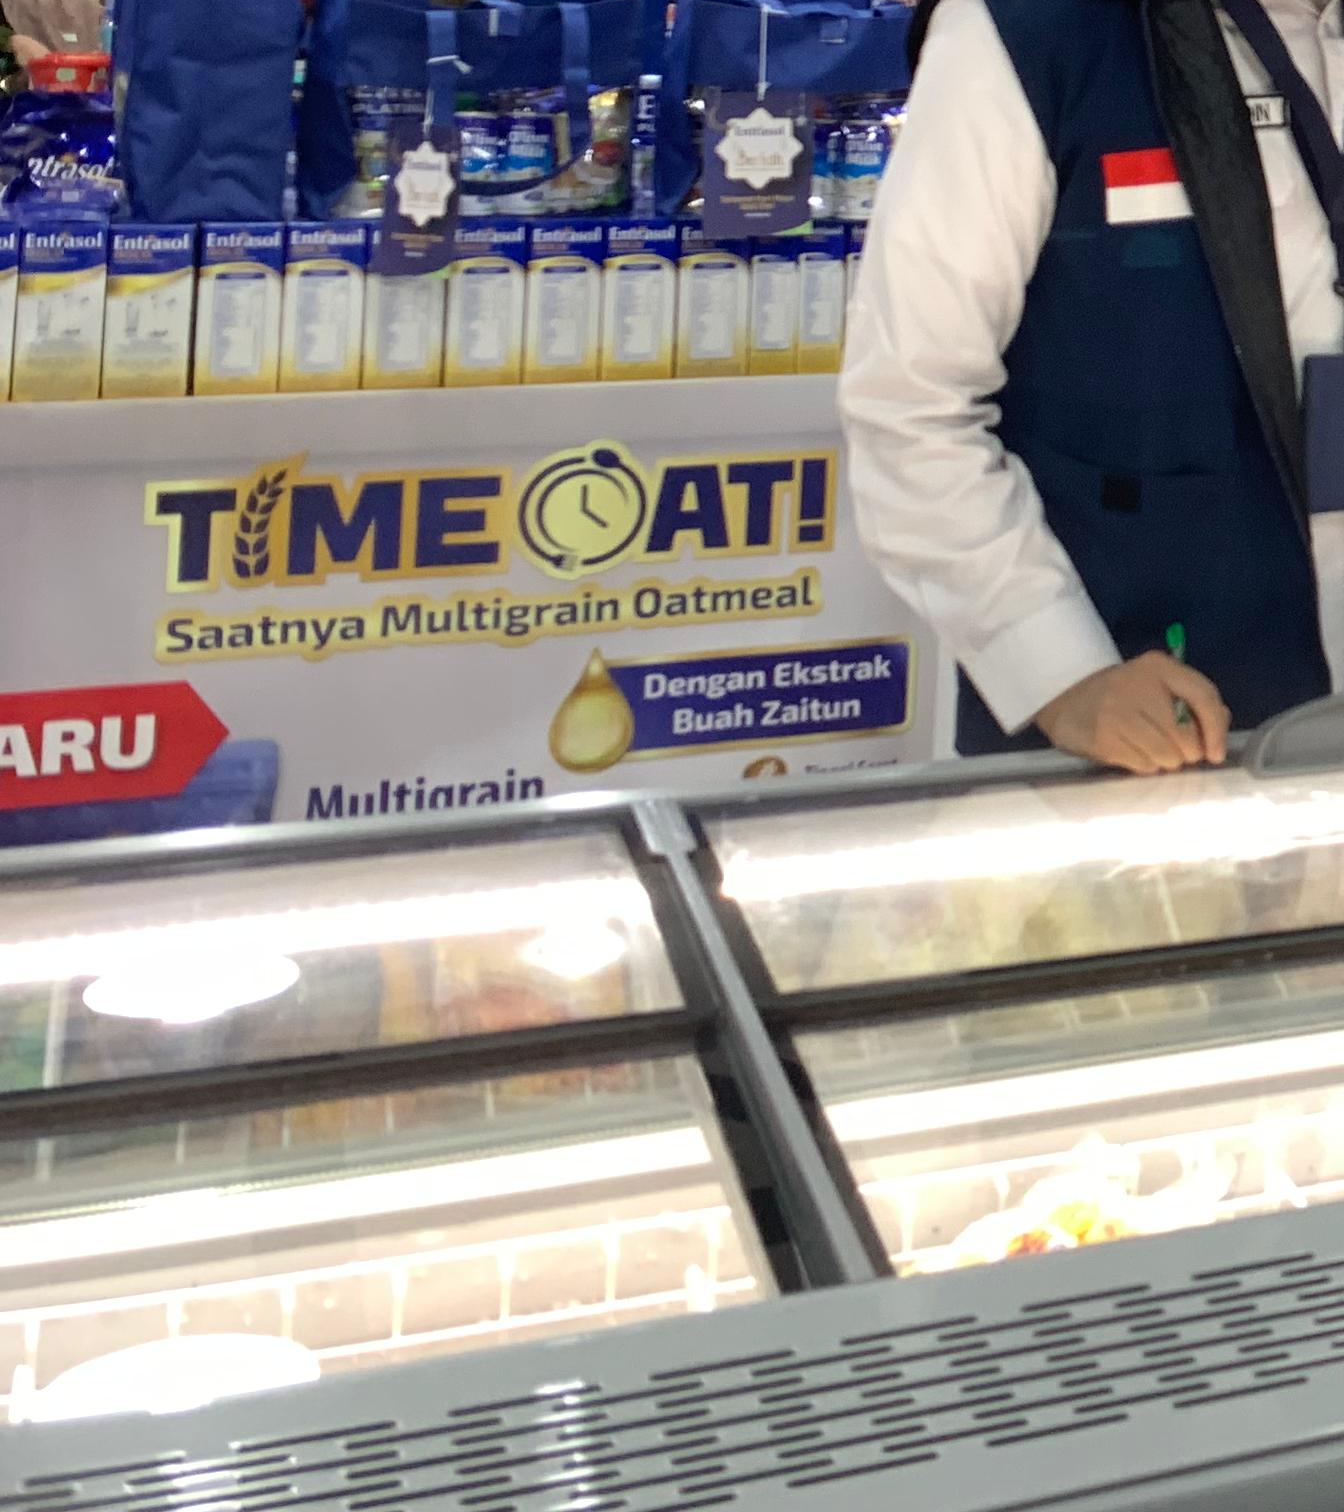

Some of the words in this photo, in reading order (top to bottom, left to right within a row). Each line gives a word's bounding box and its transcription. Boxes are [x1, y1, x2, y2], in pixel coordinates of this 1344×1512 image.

[25, 232, 103, 250] Entrasol
[113, 233, 190, 251] Entrasol
[206, 231, 282, 248] Entrasol
[290, 229, 365, 246] Entrasol
[166, 615, 365, 652] Saatnya
[381, 590, 619, 636] Multigrain
[634, 575, 813, 618] Oatmeal
[644, 671, 766, 700] Dengan
[774, 655, 892, 685] Ekstrak
[672, 705, 753, 735] Buah
[760, 697, 861, 727] Zaitun
